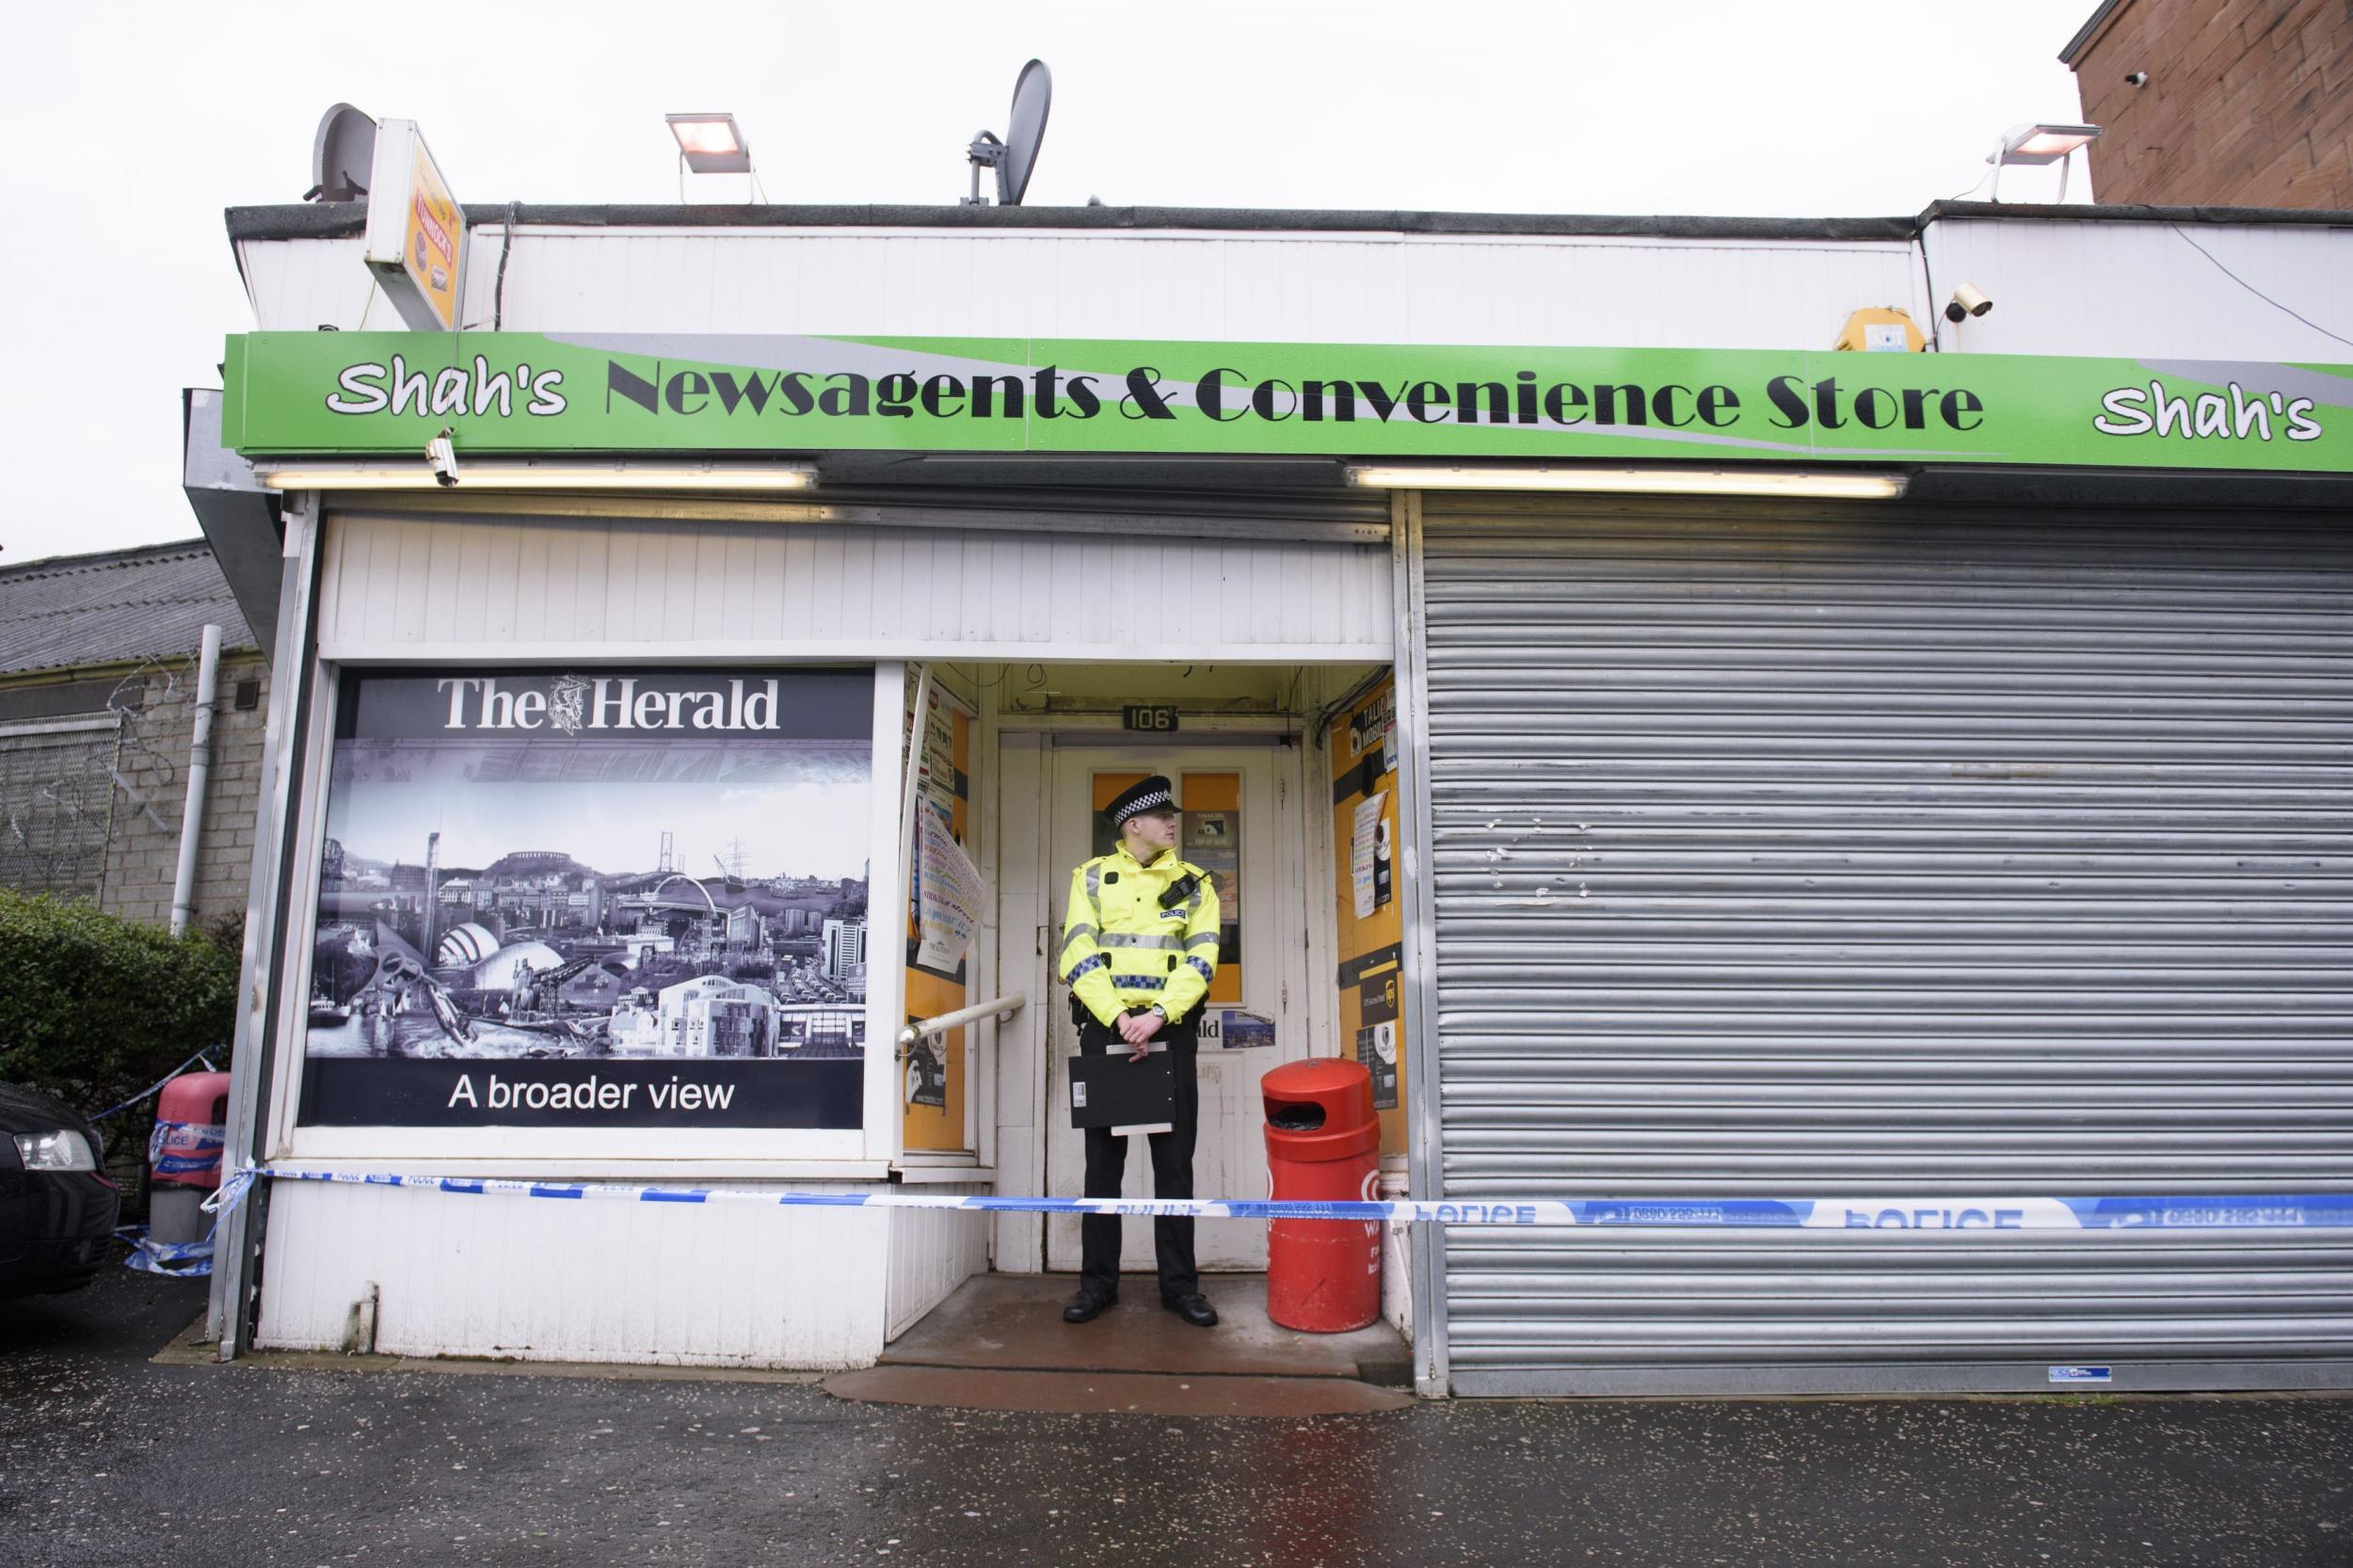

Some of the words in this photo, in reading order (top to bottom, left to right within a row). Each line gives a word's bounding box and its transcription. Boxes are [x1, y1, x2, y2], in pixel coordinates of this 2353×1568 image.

[327, 354, 567, 417] Shah's
[606, 359, 1100, 419] Newsagents
[1118, 366, 1177, 420] &
[1194, 369, 1741, 427] Convenience
[1767, 375, 1984, 431] Store
[2093, 379, 2324, 441] Shah's
[438, 678, 547, 728] The
[587, 678, 781, 729] Herald
[1132, 709, 1170, 728] 106
[1161, 909, 1185, 919] POLICE
[447, 1074, 478, 1108] A
[488, 1075, 637, 1109] broader
[648, 1076, 735, 1110] view
